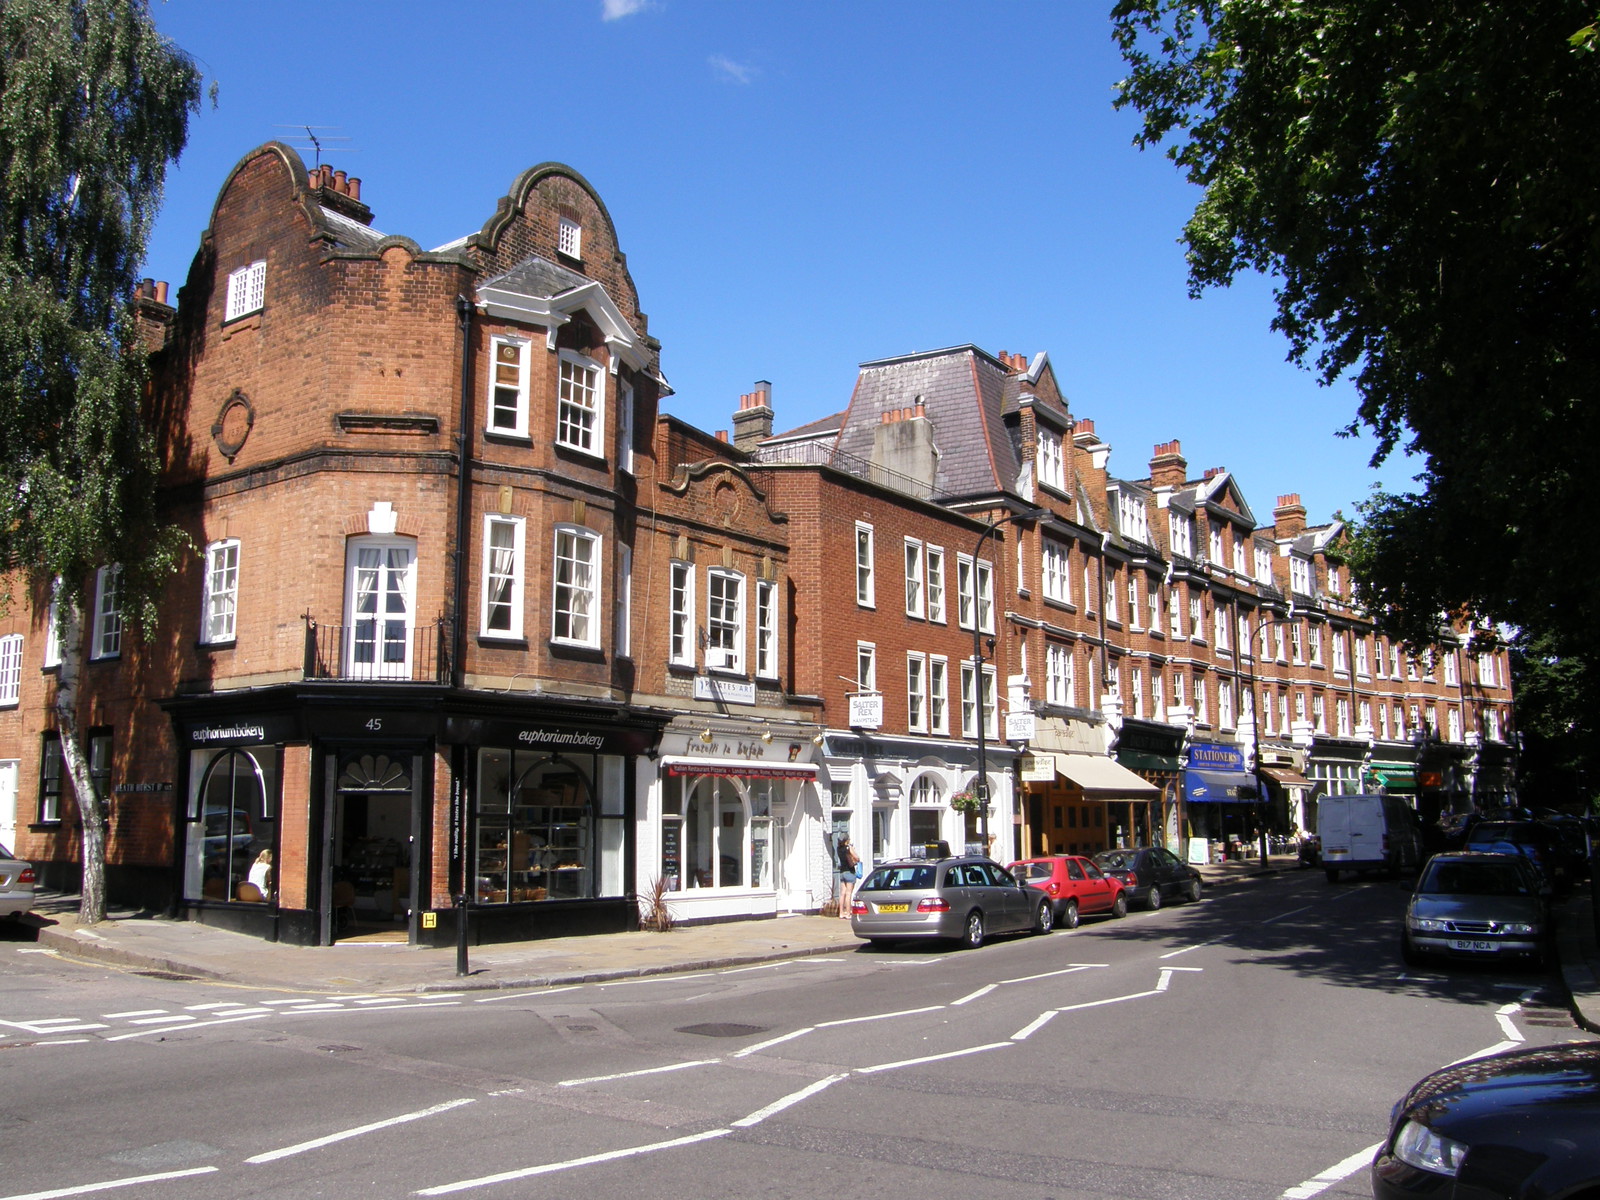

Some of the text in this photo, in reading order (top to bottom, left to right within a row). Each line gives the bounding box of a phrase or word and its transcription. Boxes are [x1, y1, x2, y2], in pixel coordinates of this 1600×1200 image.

[739, 685, 752, 693] ART
[853, 700, 879, 709] SALTER
[858, 708, 873, 716] REX
[365, 718, 382, 731] 45
[1008, 718, 1032, 726] SALTER
[683, 737, 719, 757] fratelli
[723, 743, 731, 755] la
[1194, 749, 1238, 763] STATIONERS
[1473, 941, 1492, 950] NCA
